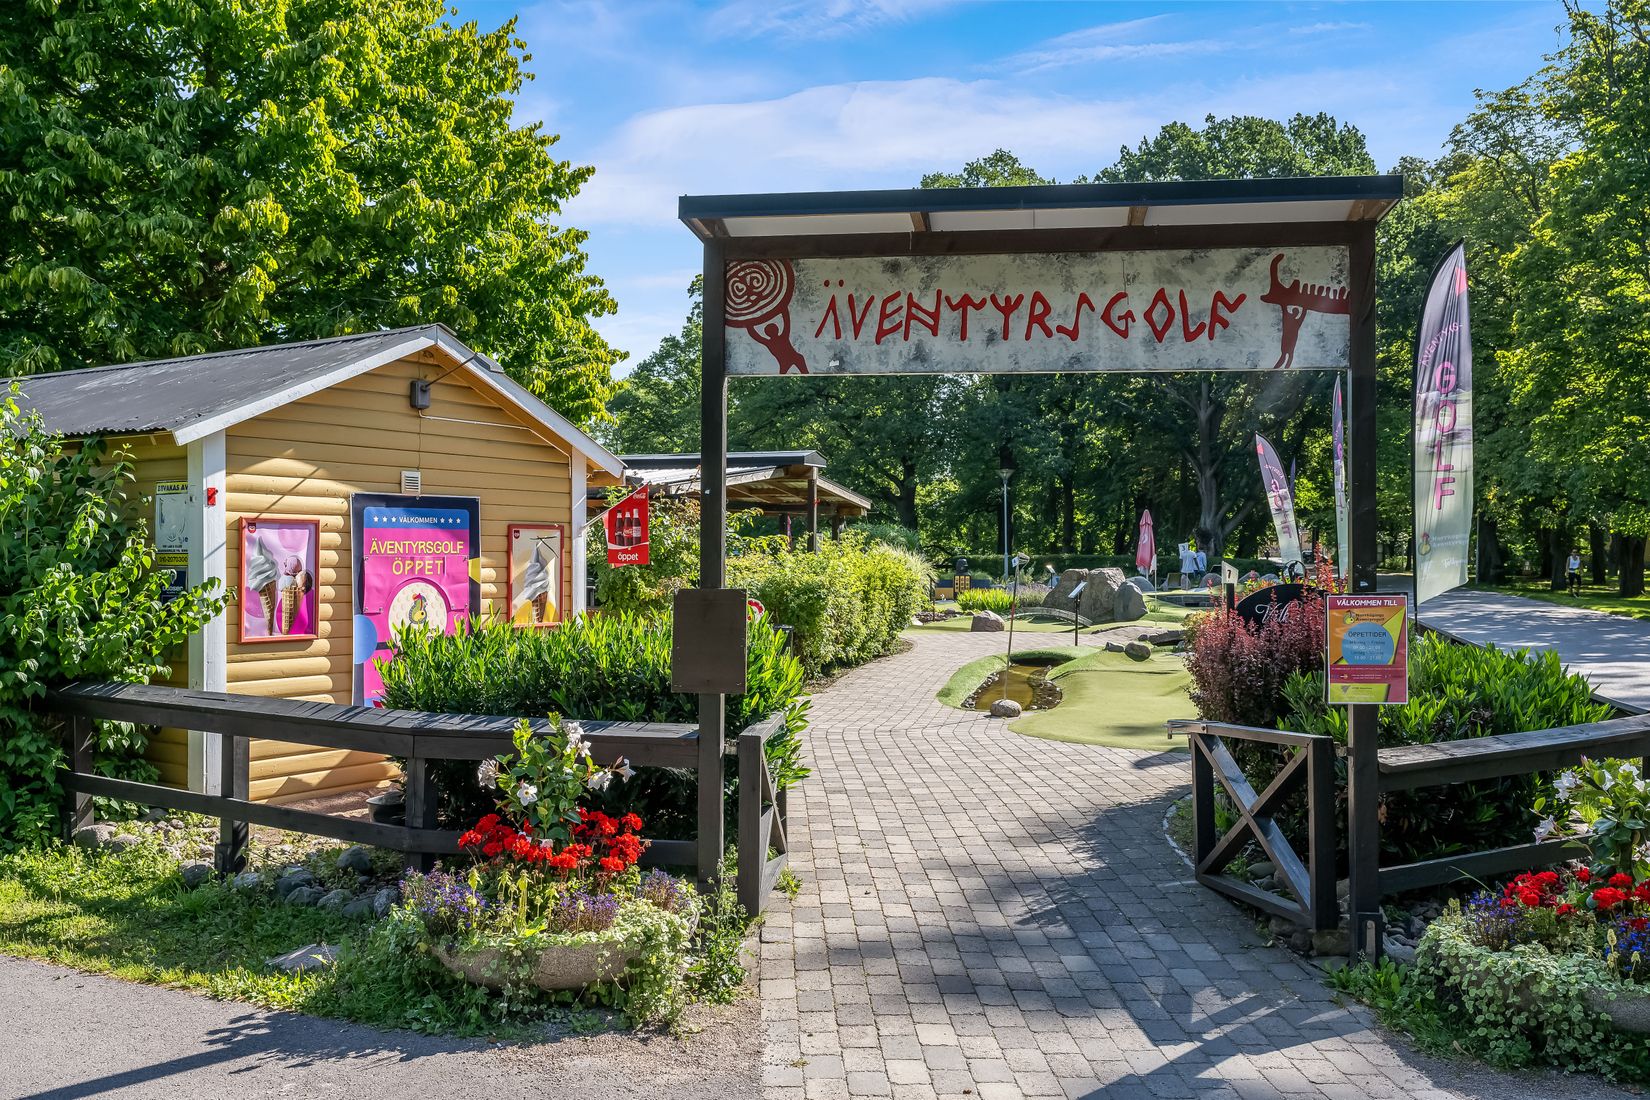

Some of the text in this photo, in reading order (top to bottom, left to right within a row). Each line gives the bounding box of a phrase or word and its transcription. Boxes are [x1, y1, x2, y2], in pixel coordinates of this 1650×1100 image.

[814, 280, 1247, 345] ÄVENTYRSGOLF
[1435, 361, 1457, 510] GOLF
[369, 538, 465, 554] ÄVENTYRSGOLF
[617, 552, 639, 562] öppet
[392, 557, 444, 575] ÖPPET
[1336, 598, 1382, 606] VÄLKOMMEN
